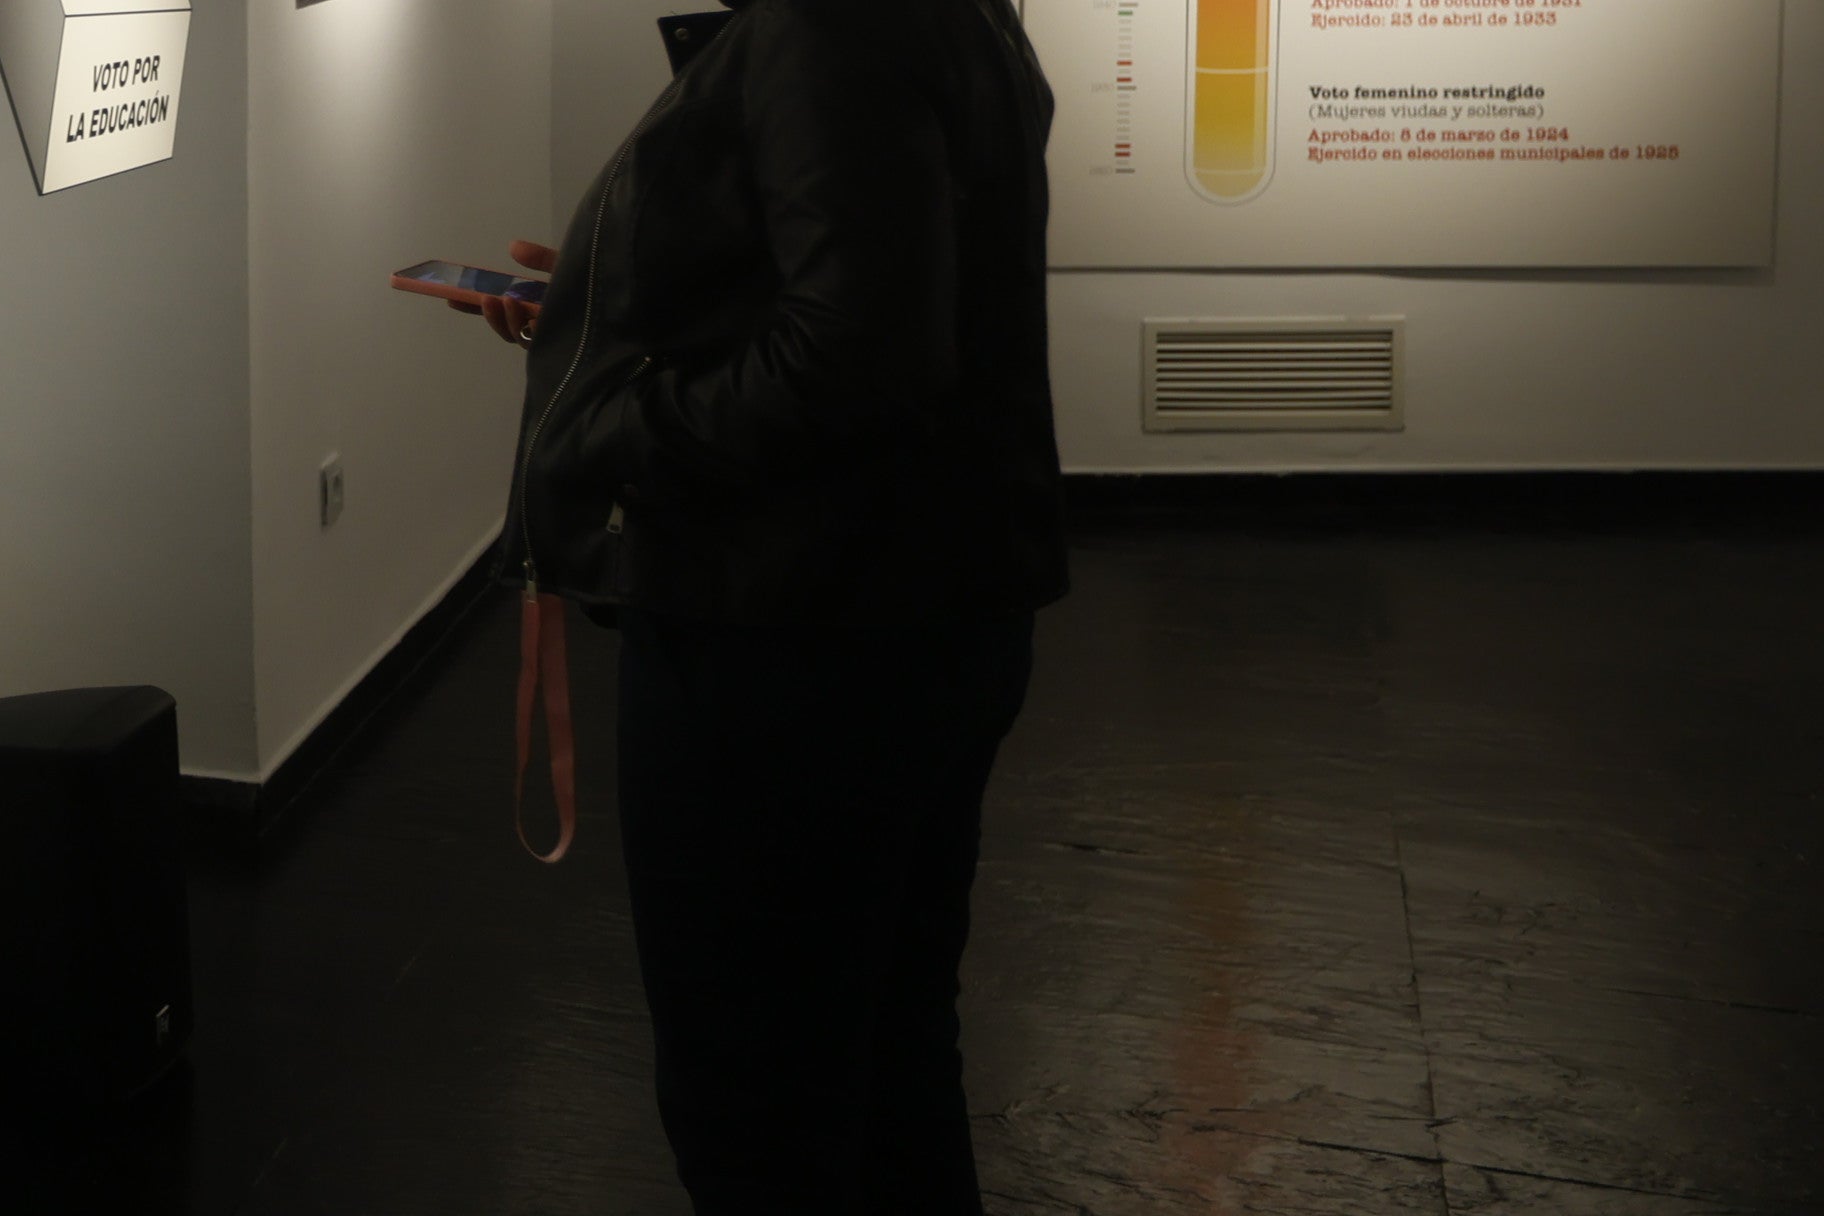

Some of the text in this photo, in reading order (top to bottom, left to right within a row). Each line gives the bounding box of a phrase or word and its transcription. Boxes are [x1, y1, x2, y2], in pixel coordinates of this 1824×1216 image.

[1418, 13, 1437, 26] de
[1443, 12, 1483, 26] abril
[1488, 13, 1507, 26] de
[93, 55, 160, 92] VOTO POR
[1309, 84, 1545, 101] Voto femenino restringido
[66, 90, 170, 143] LA EDUCACIÓN
[1308, 104, 1386, 121] (Mujeres
[1391, 104, 1447, 119] viudas
[1467, 103, 1545, 120] solteras)
[1308, 129, 1395, 144] Aprobado:
[1416, 129, 1436, 142] de
[1441, 129, 1495, 142] marzo
[1500, 129, 1520, 142] de
[1308, 147, 1376, 164] Ejercido
[1382, 147, 1402, 161] en
[1407, 147, 1495, 161] elecciones
[1500, 146, 1604, 163] municipales
[1609, 147, 1629, 161] de
